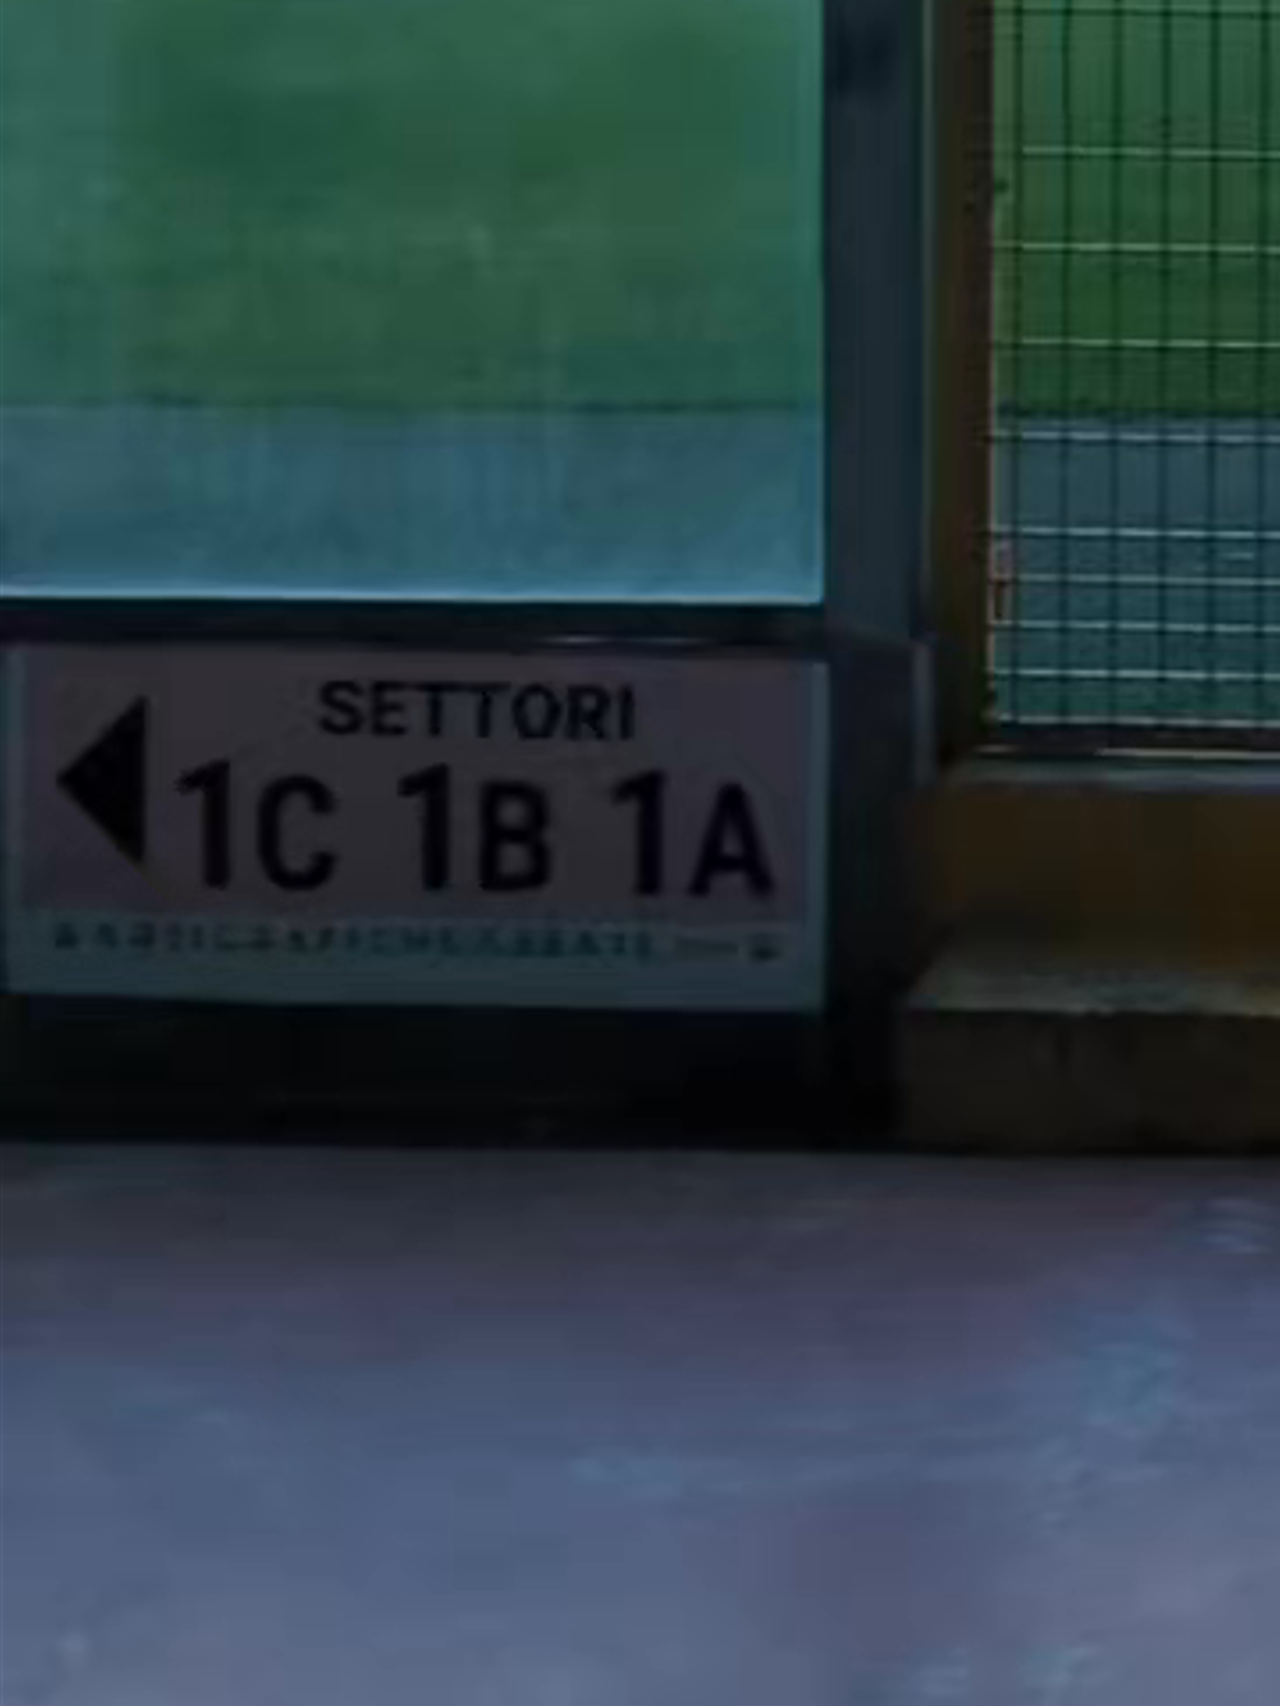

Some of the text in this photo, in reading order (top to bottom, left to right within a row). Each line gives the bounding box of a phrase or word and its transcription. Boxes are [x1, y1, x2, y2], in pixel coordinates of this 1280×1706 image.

[319, 680, 635, 741] SETTORI
[174, 759, 777, 898] 1C 1B 1A
